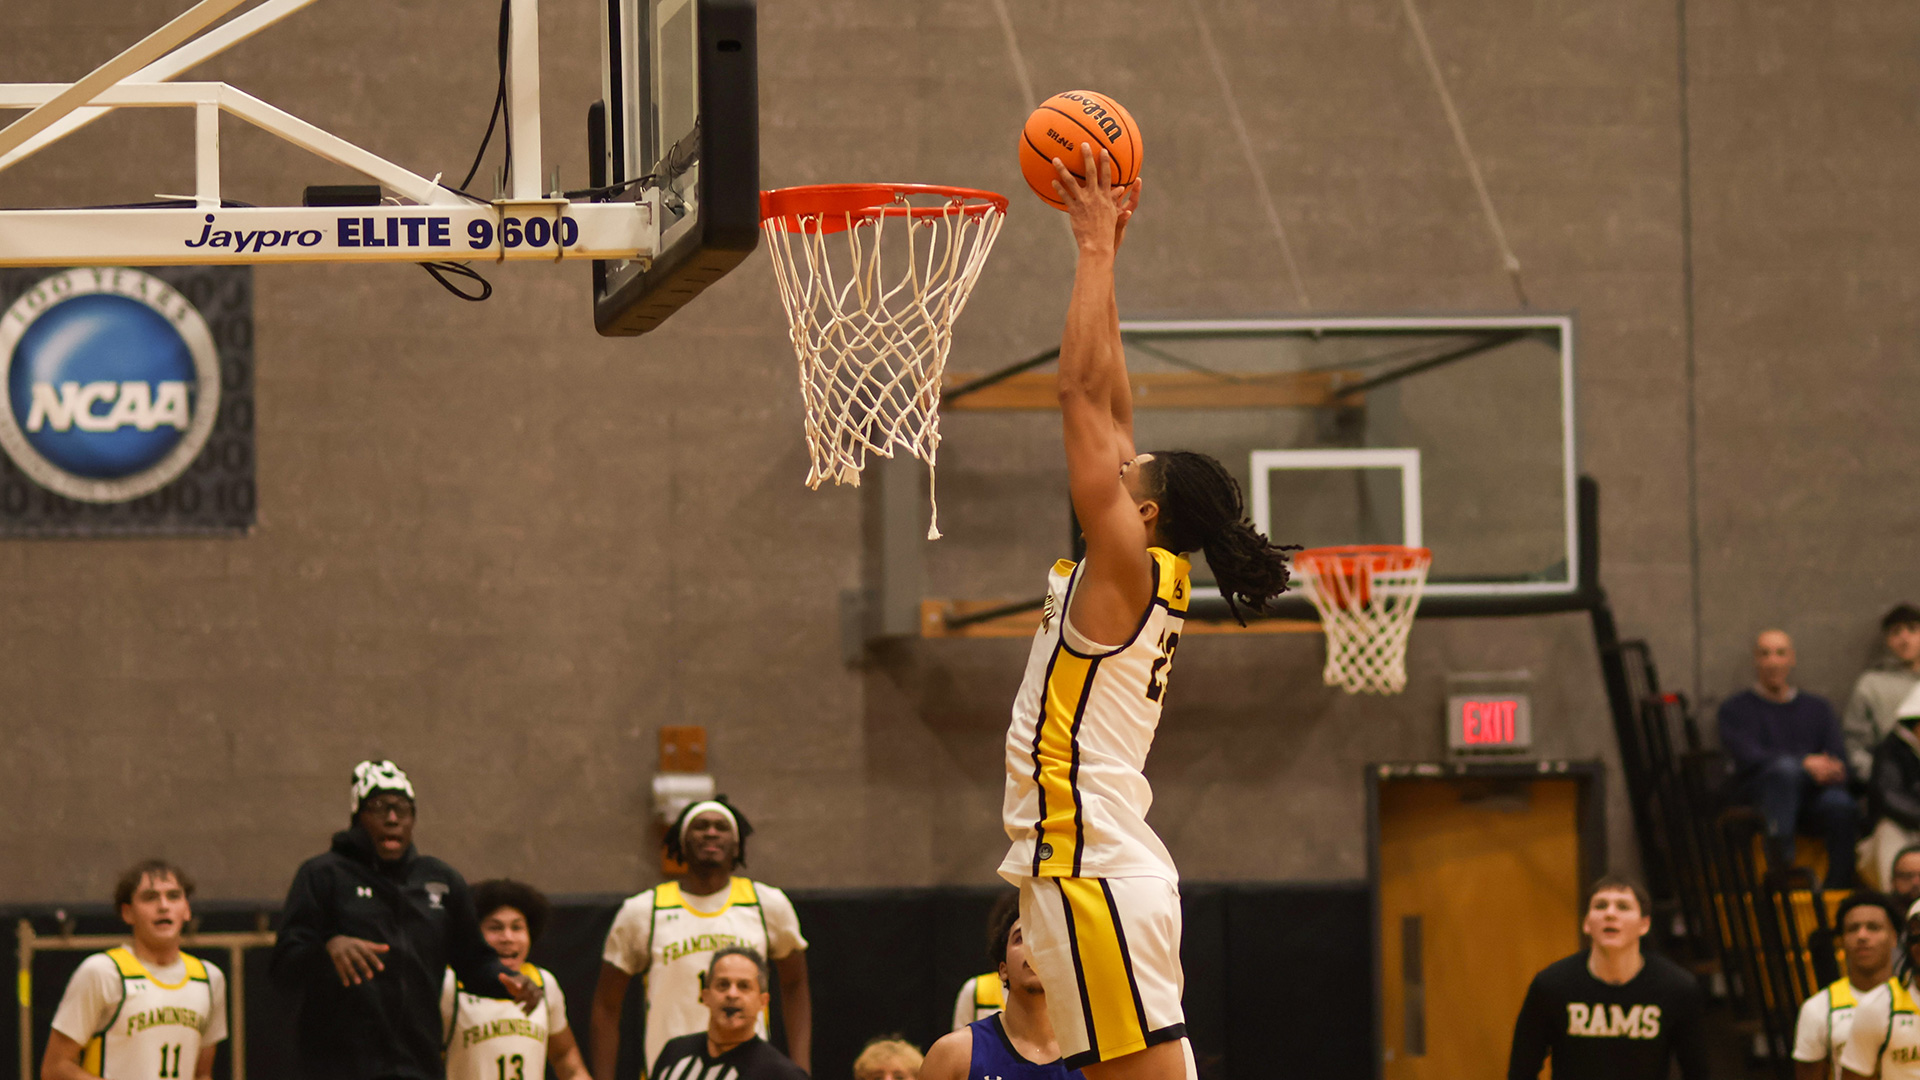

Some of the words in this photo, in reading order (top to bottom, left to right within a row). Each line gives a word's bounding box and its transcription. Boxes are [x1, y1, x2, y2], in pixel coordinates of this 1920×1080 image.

[1059, 91, 1123, 144] Wilson
[184, 213, 323, 253] jaypro
[337, 217, 451, 247] ELITE
[467, 216, 579, 250] 9600
[11, 274, 72, 323] 100
[91, 266, 188, 322] YEARS
[26, 380, 189, 432] NCAA
[1462, 700, 1518, 744] EXIT
[127, 1006, 208, 1036] FRAMINGH
[1567, 1002, 1661, 1039] RAMS
[159, 1043, 181, 1078] 11
[496, 1053, 524, 1080] 13
